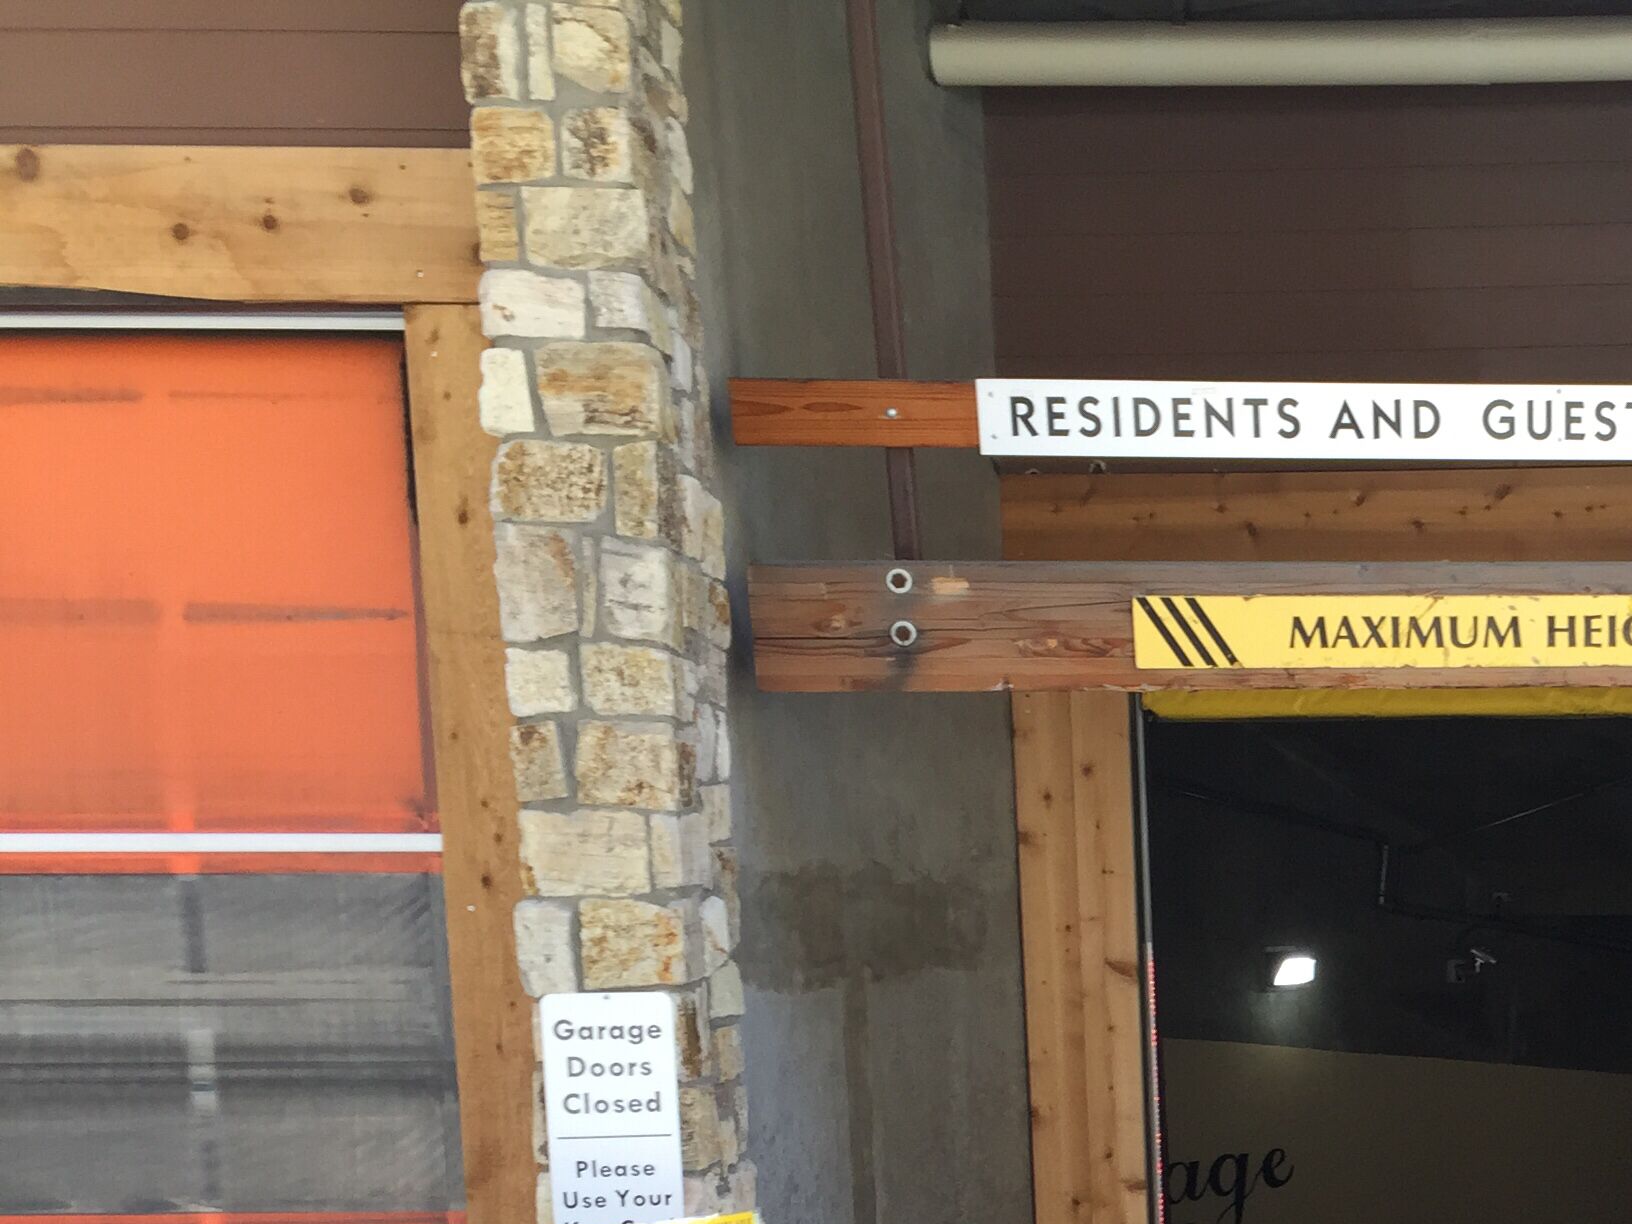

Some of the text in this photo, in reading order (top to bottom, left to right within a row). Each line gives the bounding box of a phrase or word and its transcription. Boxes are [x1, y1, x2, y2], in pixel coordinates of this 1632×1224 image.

[1009, 396, 1301, 438] RESIDENTS
[1329, 399, 1441, 439] AND
[1288, 615, 1523, 649] MAXIMUM
[554, 1020, 663, 1044] Garage
[566, 1056, 653, 1078] Doors
[563, 1091, 663, 1114] Closed
[576, 1160, 656, 1178] Please
[563, 1189, 673, 1209] Use Your
